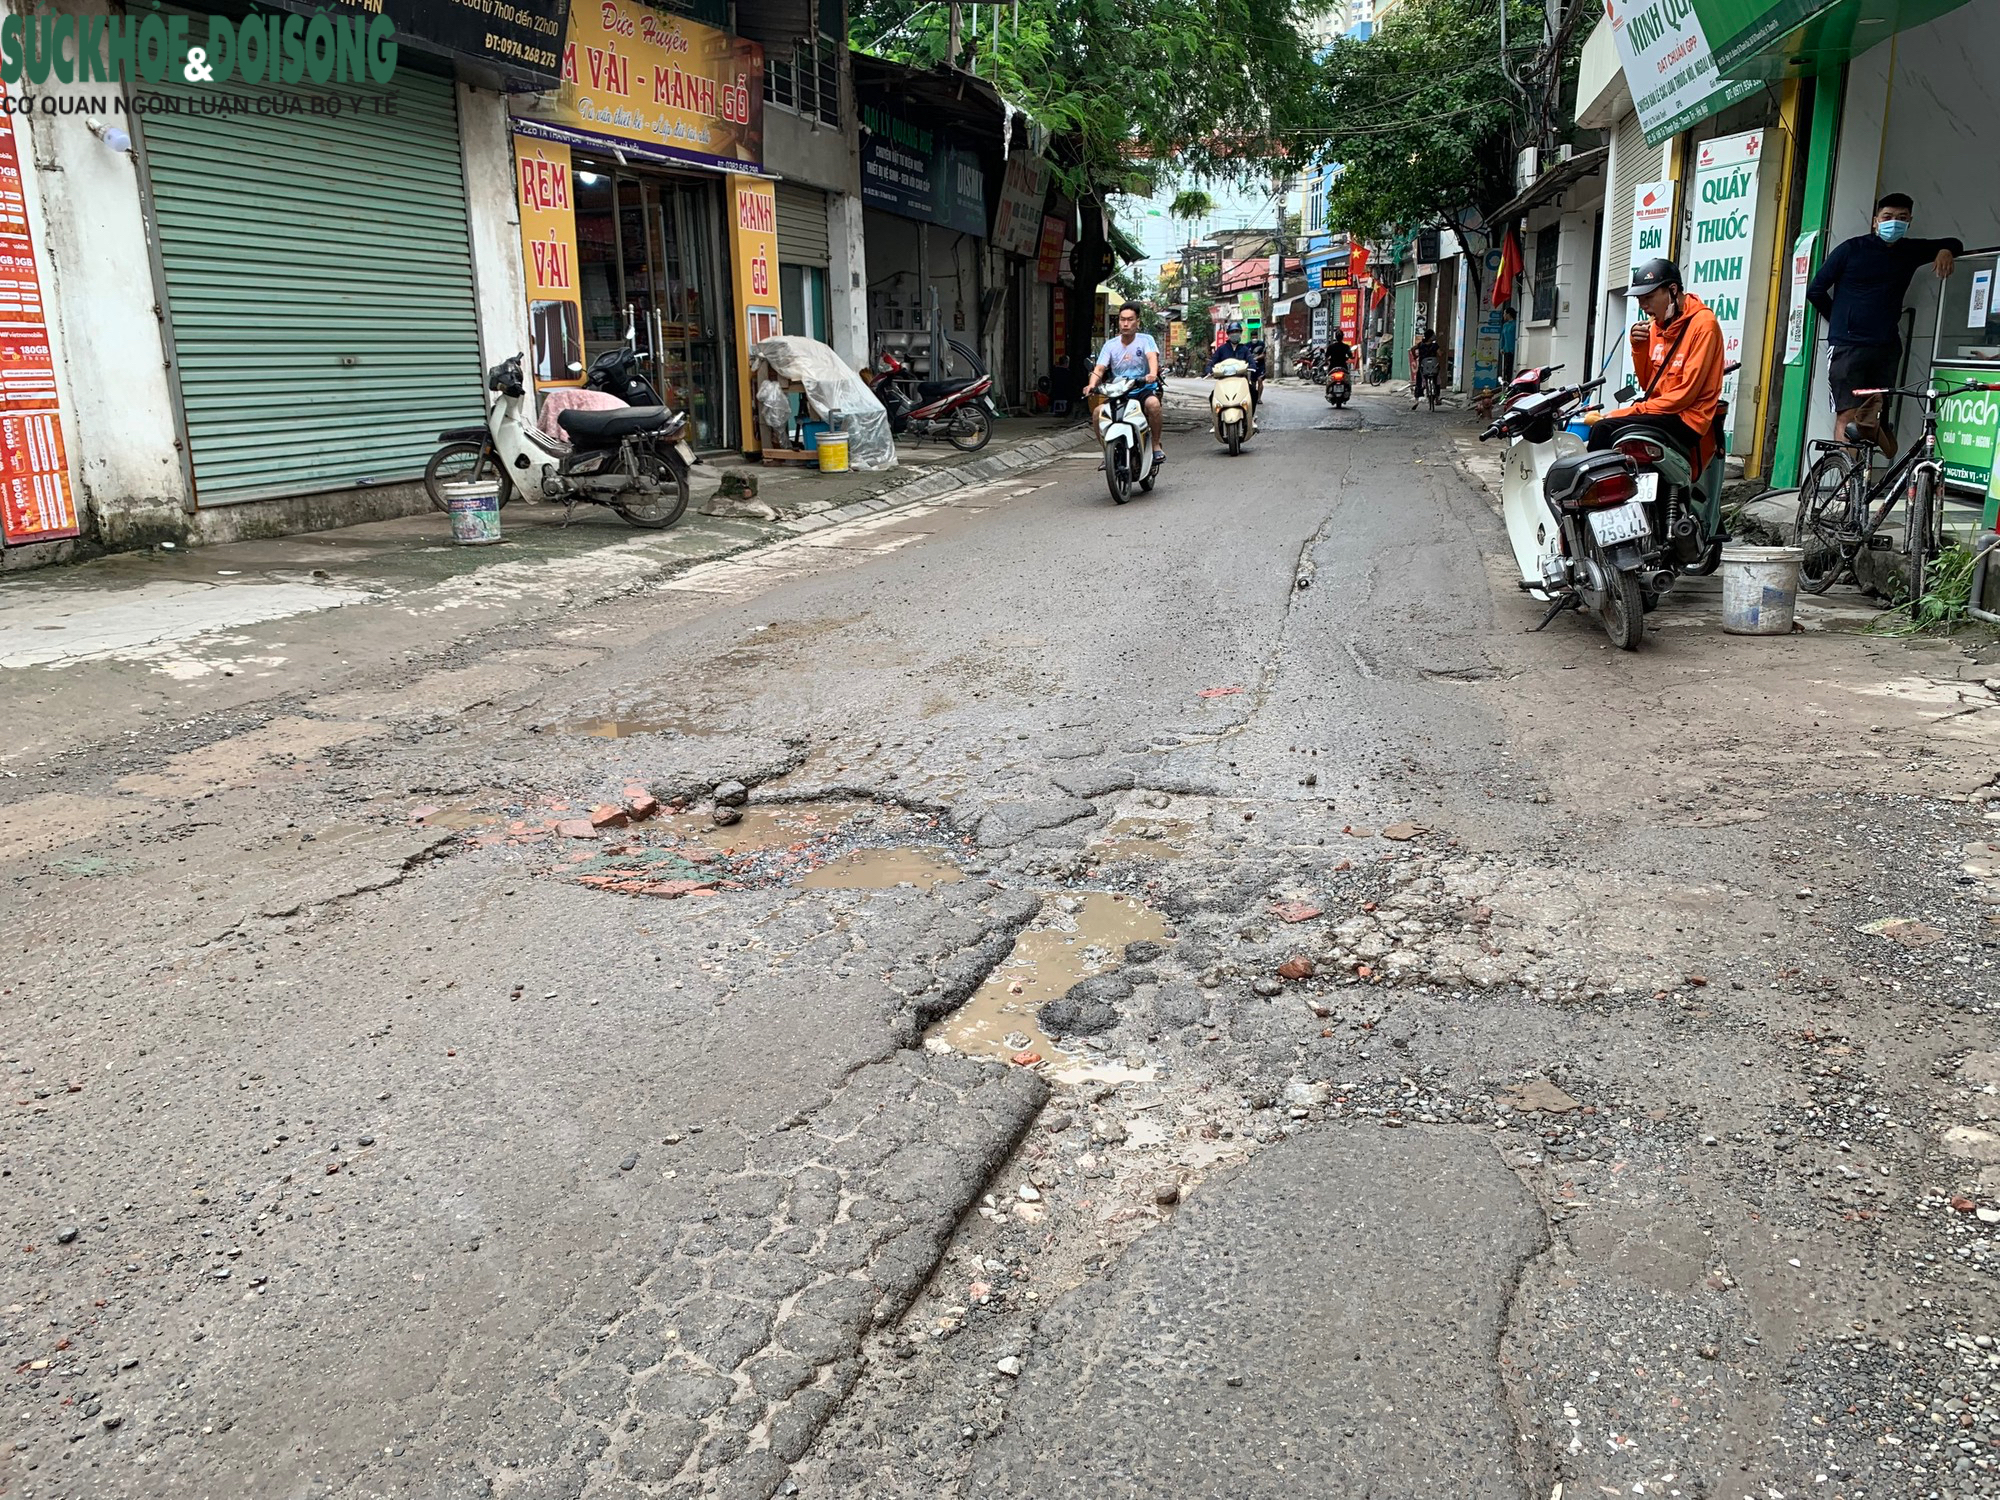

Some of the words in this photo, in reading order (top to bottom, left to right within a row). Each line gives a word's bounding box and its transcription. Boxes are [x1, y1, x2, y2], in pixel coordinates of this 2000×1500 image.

[493, 1, 515, 21] 7h00
[516, 10, 533, 29] đến
[534, 16, 559, 37] 22h00
[601, 1, 635, 37] Đức
[640, 15, 689, 55] Huyền
[1626, 2, 1665, 57] MINH
[1662, 0, 1692, 32] QU
[1685, 35, 1698, 53] GPP
[586, 41, 630, 97] VẢI
[653, 60, 717, 117] MÀNH
[722, 73, 750, 125] GỖ
[520, 148, 570, 212] RÈM
[1702, 166, 1752, 205] QUẦY
[738, 184, 774, 232] MÀNH
[1645, 207, 1670, 216] PHARMACY
[1697, 208, 1749, 244] THUỐC
[1639, 226, 1662, 250] BÁN
[530, 228, 570, 288] VẢI
[751, 243, 769, 296] GỖ
[1693, 256, 1744, 283] MINH
[20, 345, 49, 355] 180GB
[1599, 519, 1647, 544] 259.44
